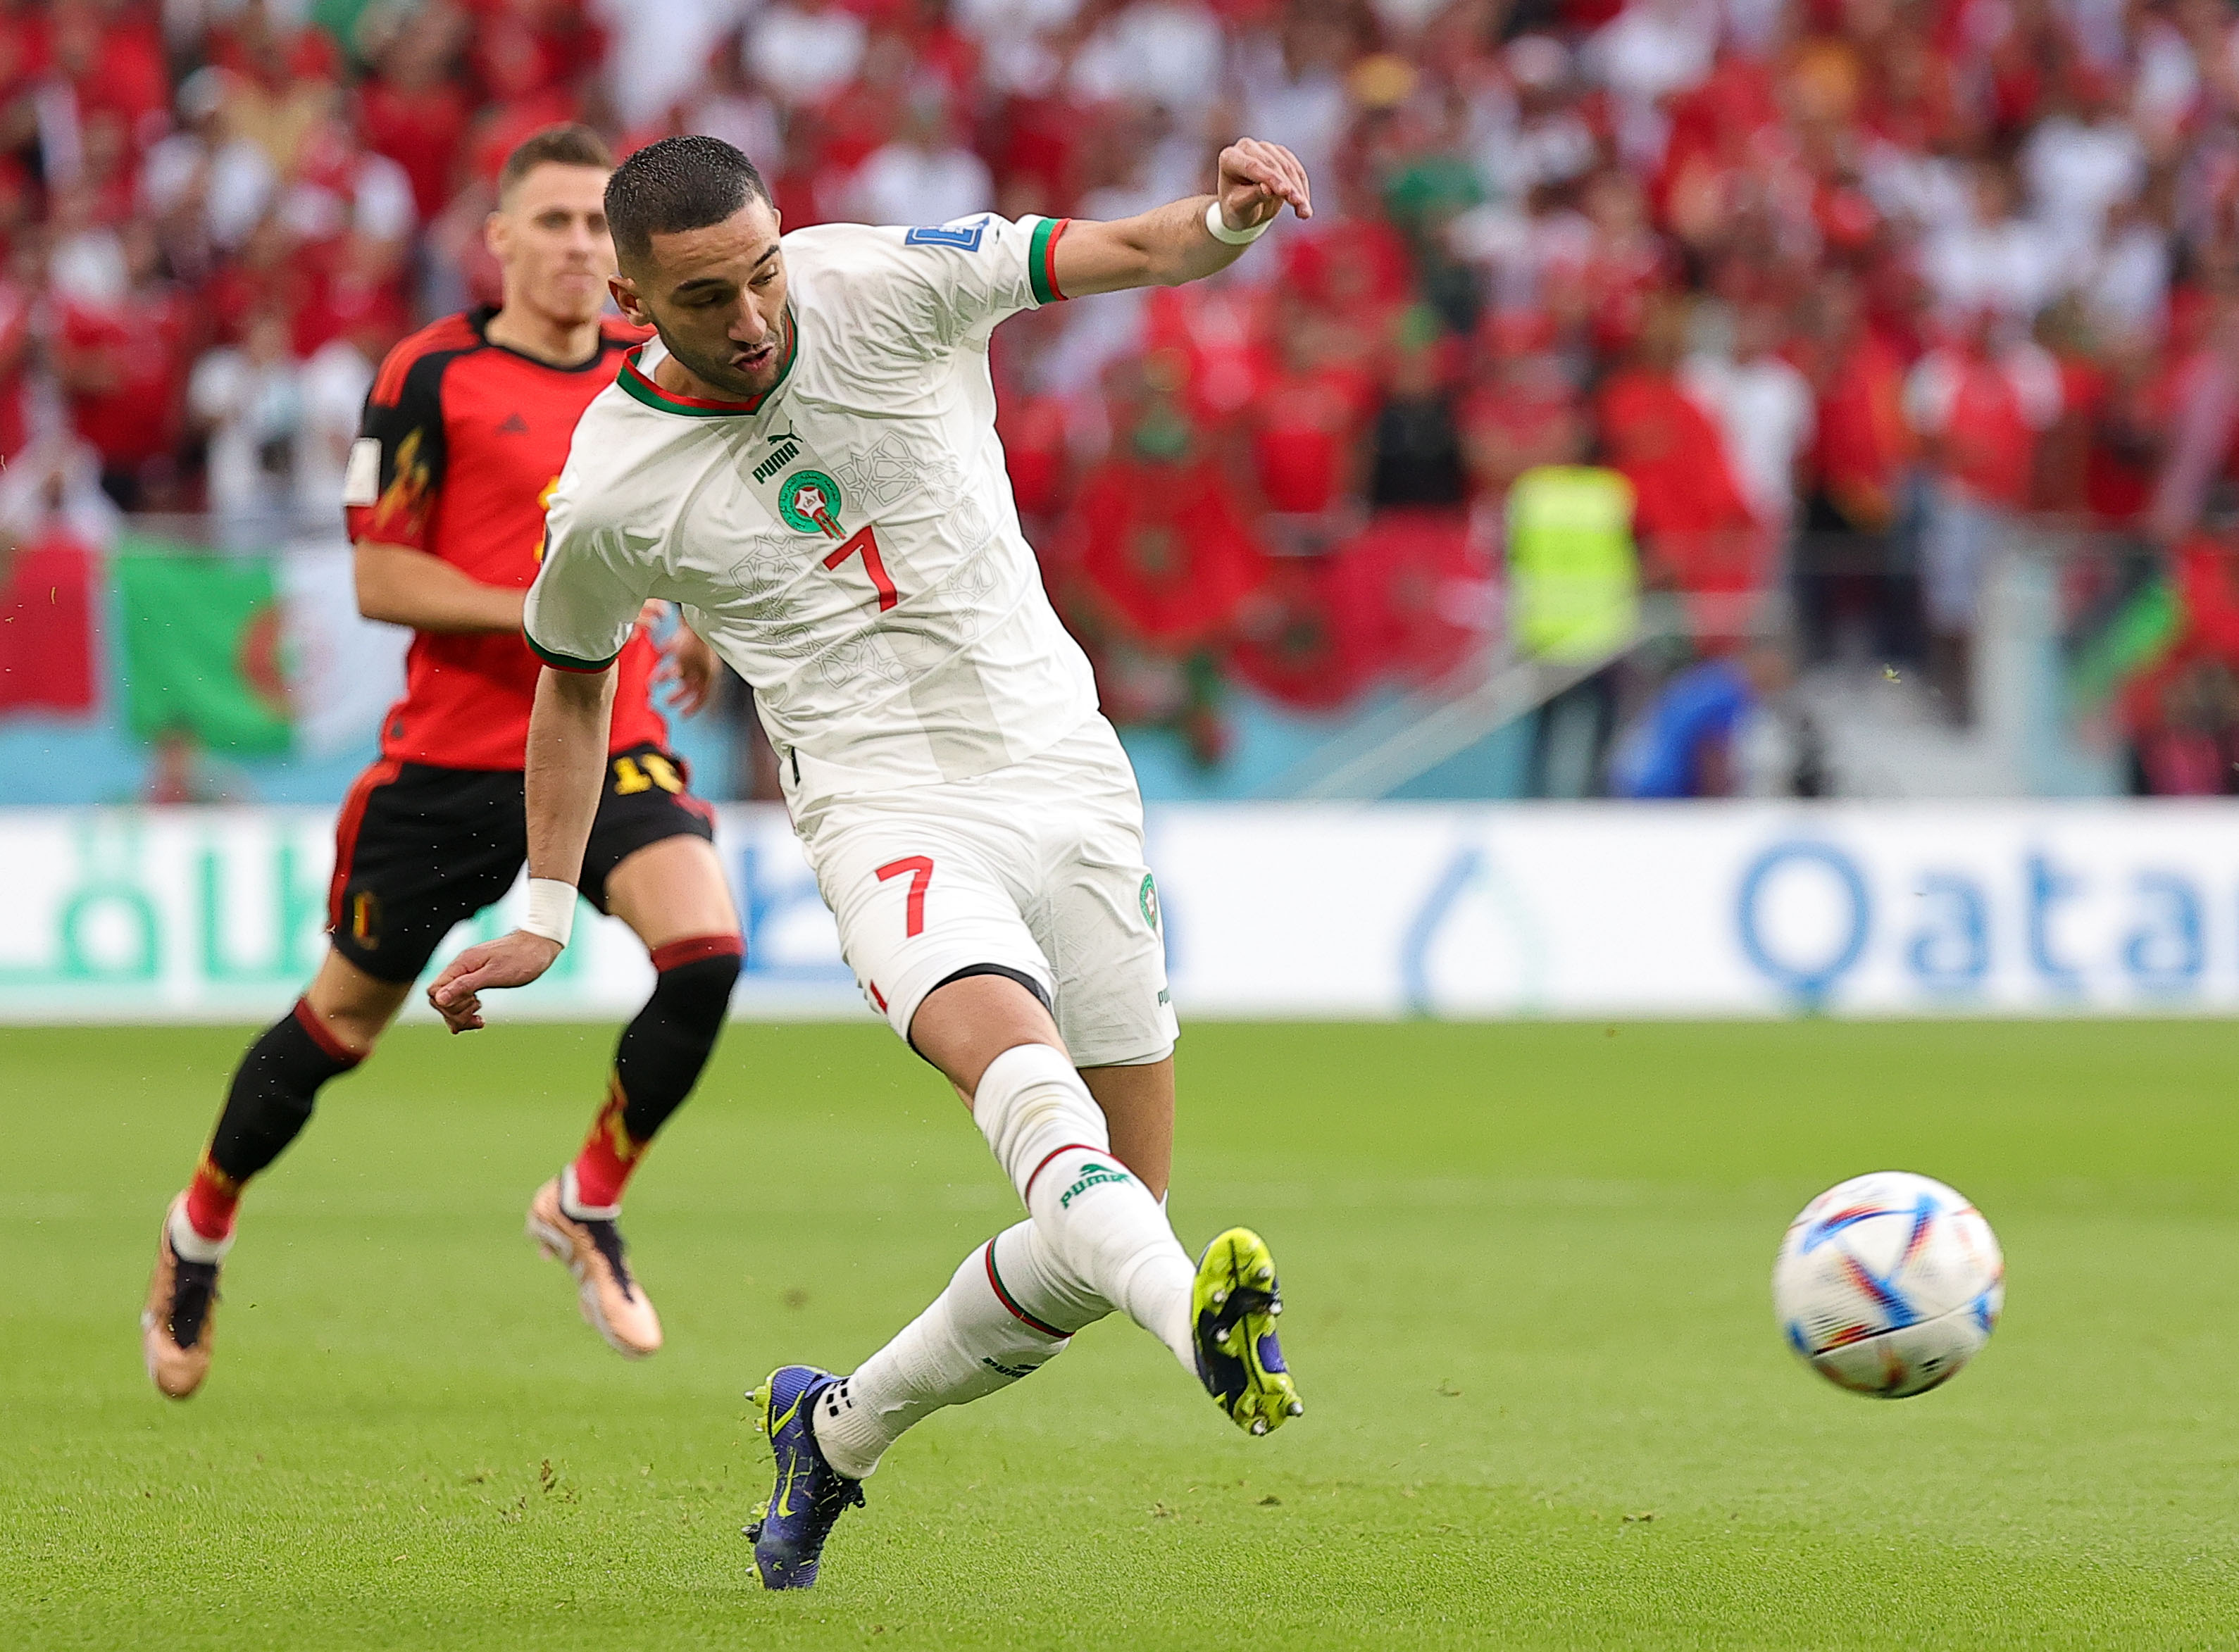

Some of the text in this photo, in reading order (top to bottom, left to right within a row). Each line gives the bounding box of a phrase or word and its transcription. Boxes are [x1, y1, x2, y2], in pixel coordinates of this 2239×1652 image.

[751, 441, 800, 484] PUMA
[822, 524, 898, 613] 7
[875, 855, 934, 939] 7
[1734, 837, 2239, 1014] Qata
